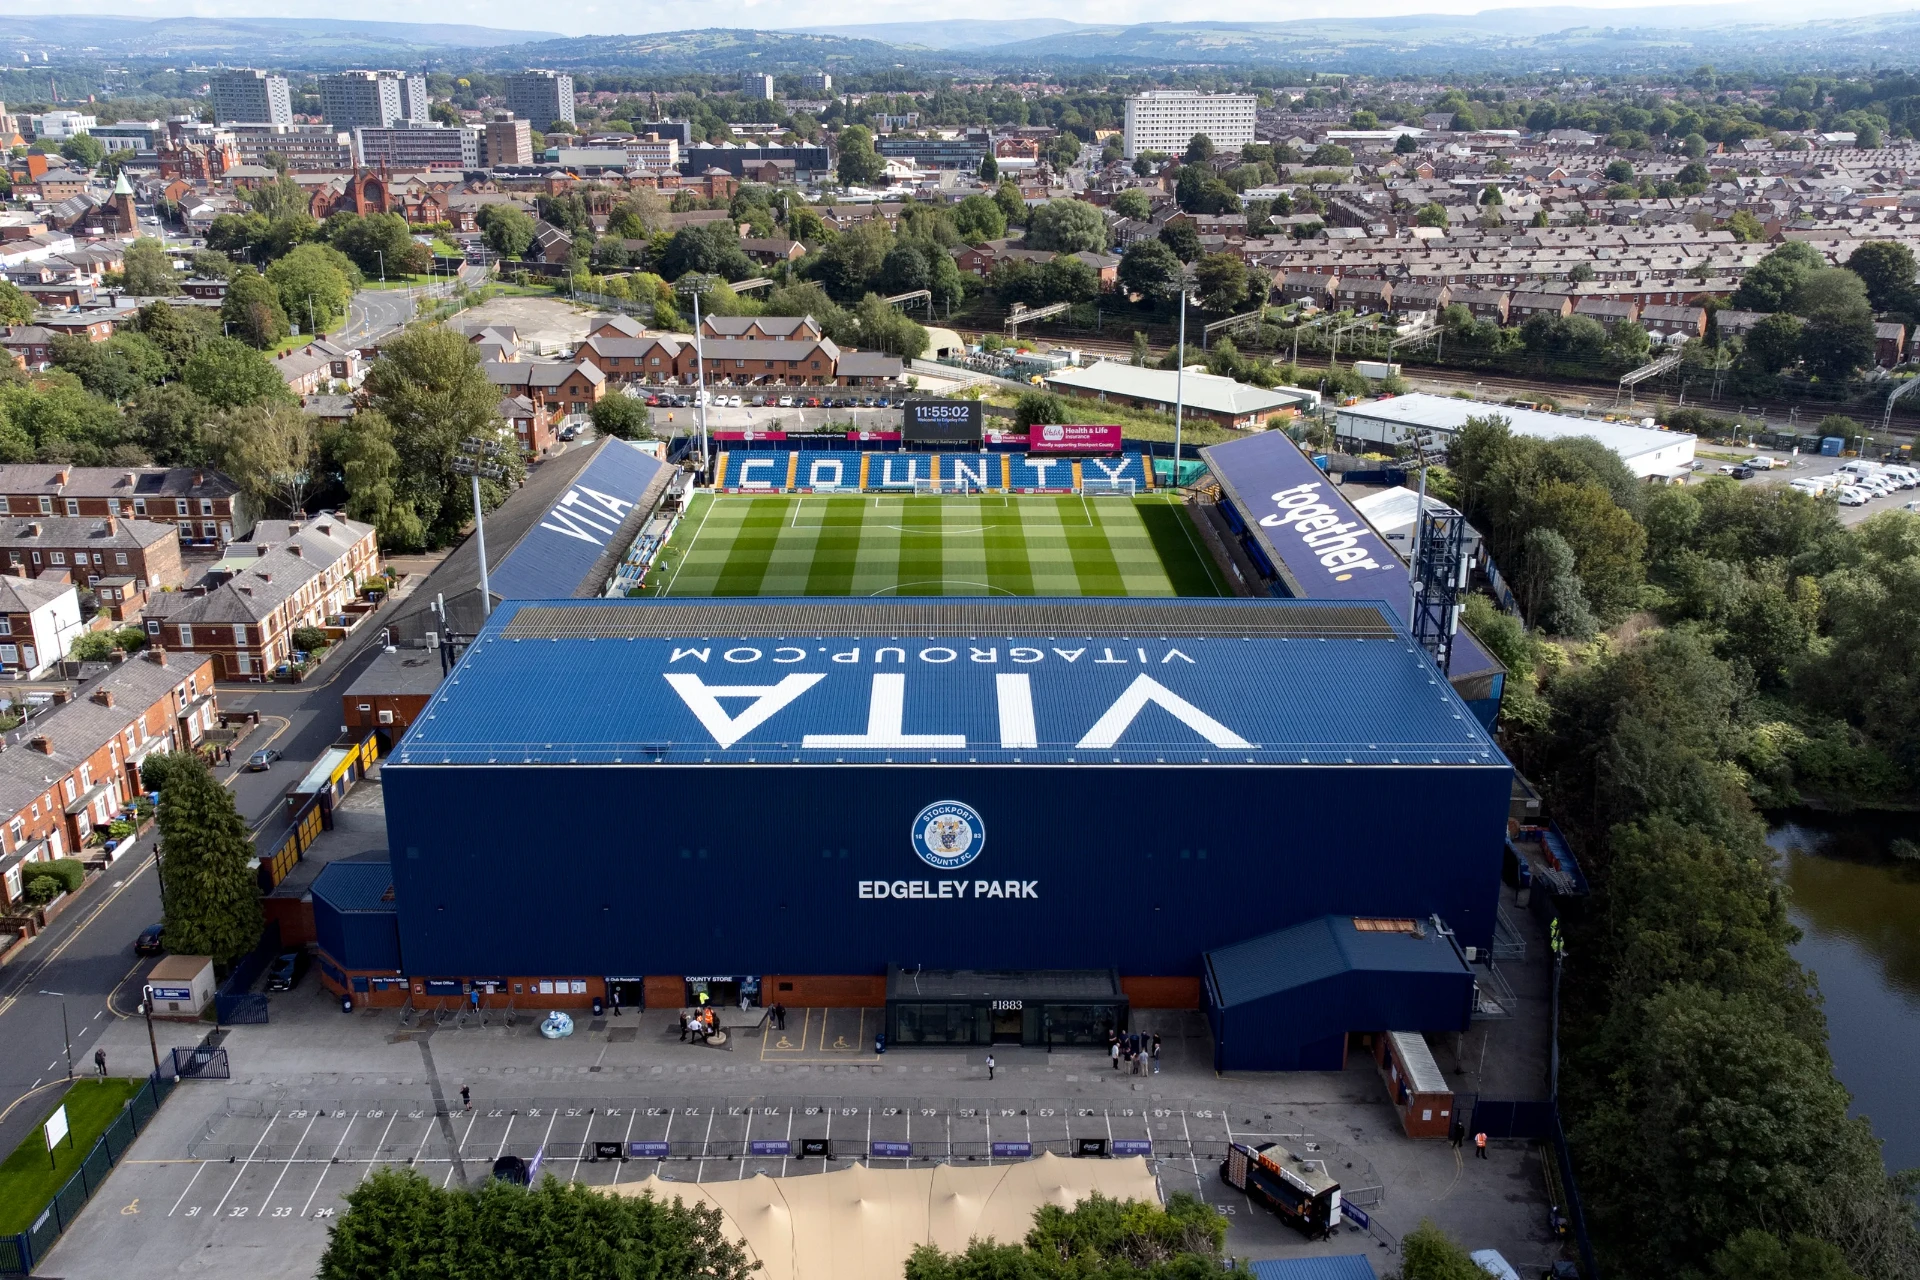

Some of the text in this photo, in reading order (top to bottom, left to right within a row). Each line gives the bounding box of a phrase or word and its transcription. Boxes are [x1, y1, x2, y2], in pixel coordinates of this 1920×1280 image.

[915, 406, 969, 417] 11:55:02
[1044, 427, 1062, 436] Vitality
[739, 459, 1131, 488] COUNTY
[540, 484, 633, 546] VITA
[670, 647, 1196, 664] VITAGROUP.COM
[663, 673, 1256, 750] VITA
[923, 806, 974, 822] STOCKPORT
[926, 852, 972, 866] COUNTY FC
[858, 881, 1039, 899] EDGELEY PARK
[998, 1000, 1022, 1010] 1883
[367, 1110, 383, 1118] 80
[408, 1110, 423, 1118] 79
[450, 1110, 464, 1118] 78
[529, 1109, 542, 1117] 76
[1197, 1110, 1212, 1118] 59
[185, 1207, 201, 1216] 31
[228, 1207, 248, 1217] 32
[272, 1207, 292, 1217] 33
[315, 1207, 334, 1217] 34
[1218, 1205, 1236, 1215] 55
